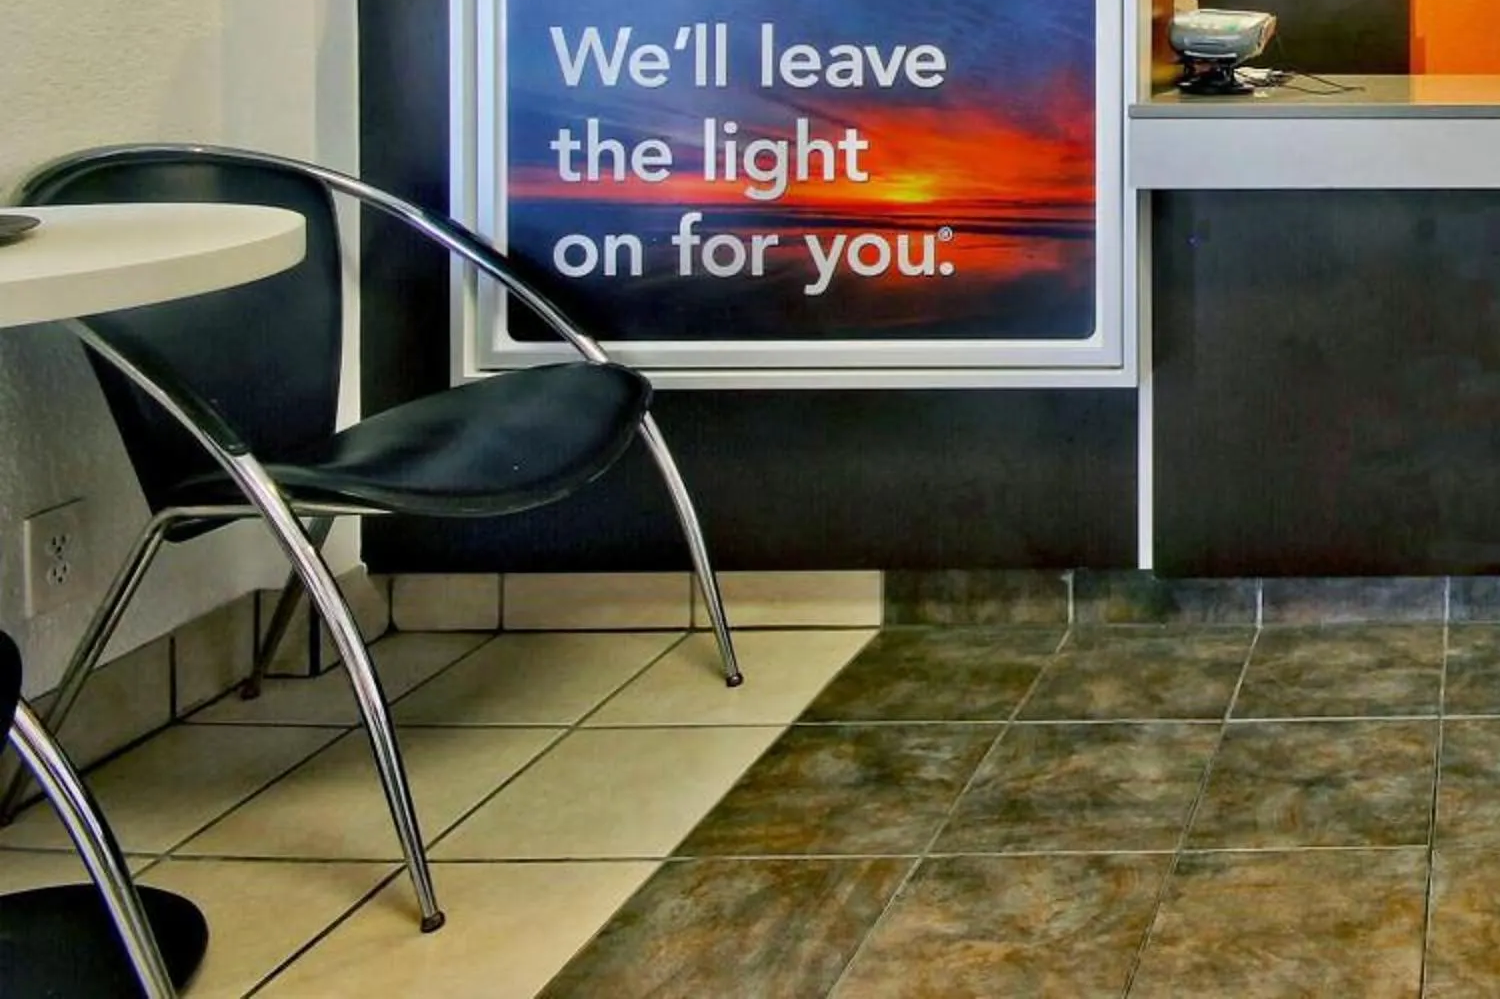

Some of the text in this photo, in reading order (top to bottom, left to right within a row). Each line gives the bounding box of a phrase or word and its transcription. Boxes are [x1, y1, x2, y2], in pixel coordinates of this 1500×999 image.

[549, 23, 948, 89] We'll leave
[549, 118, 870, 202] the light
[552, 232, 644, 278] on
[671, 211, 778, 277] for
